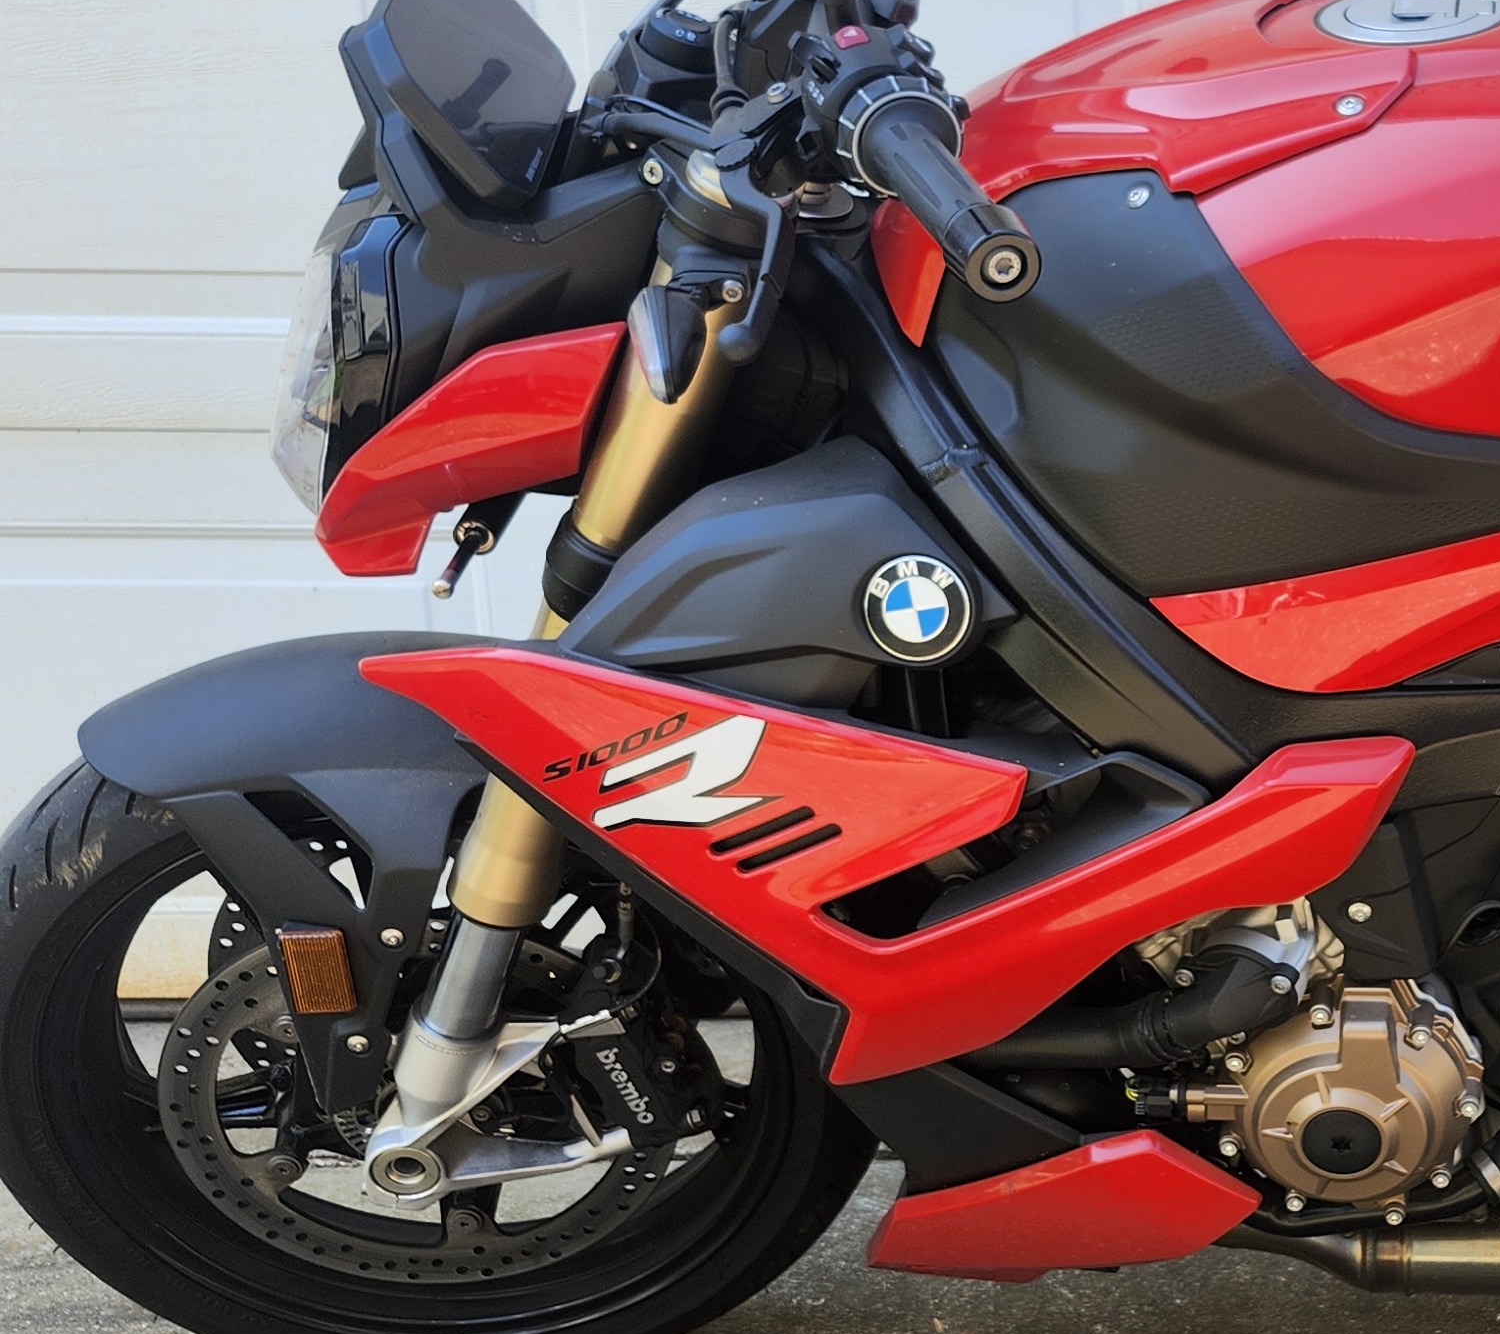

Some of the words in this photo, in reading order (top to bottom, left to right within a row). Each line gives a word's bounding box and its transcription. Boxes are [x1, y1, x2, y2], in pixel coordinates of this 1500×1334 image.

[869, 559, 956, 599] BMW
[543, 711, 689, 783] S1000
[595, 1047, 655, 1125] brembo
